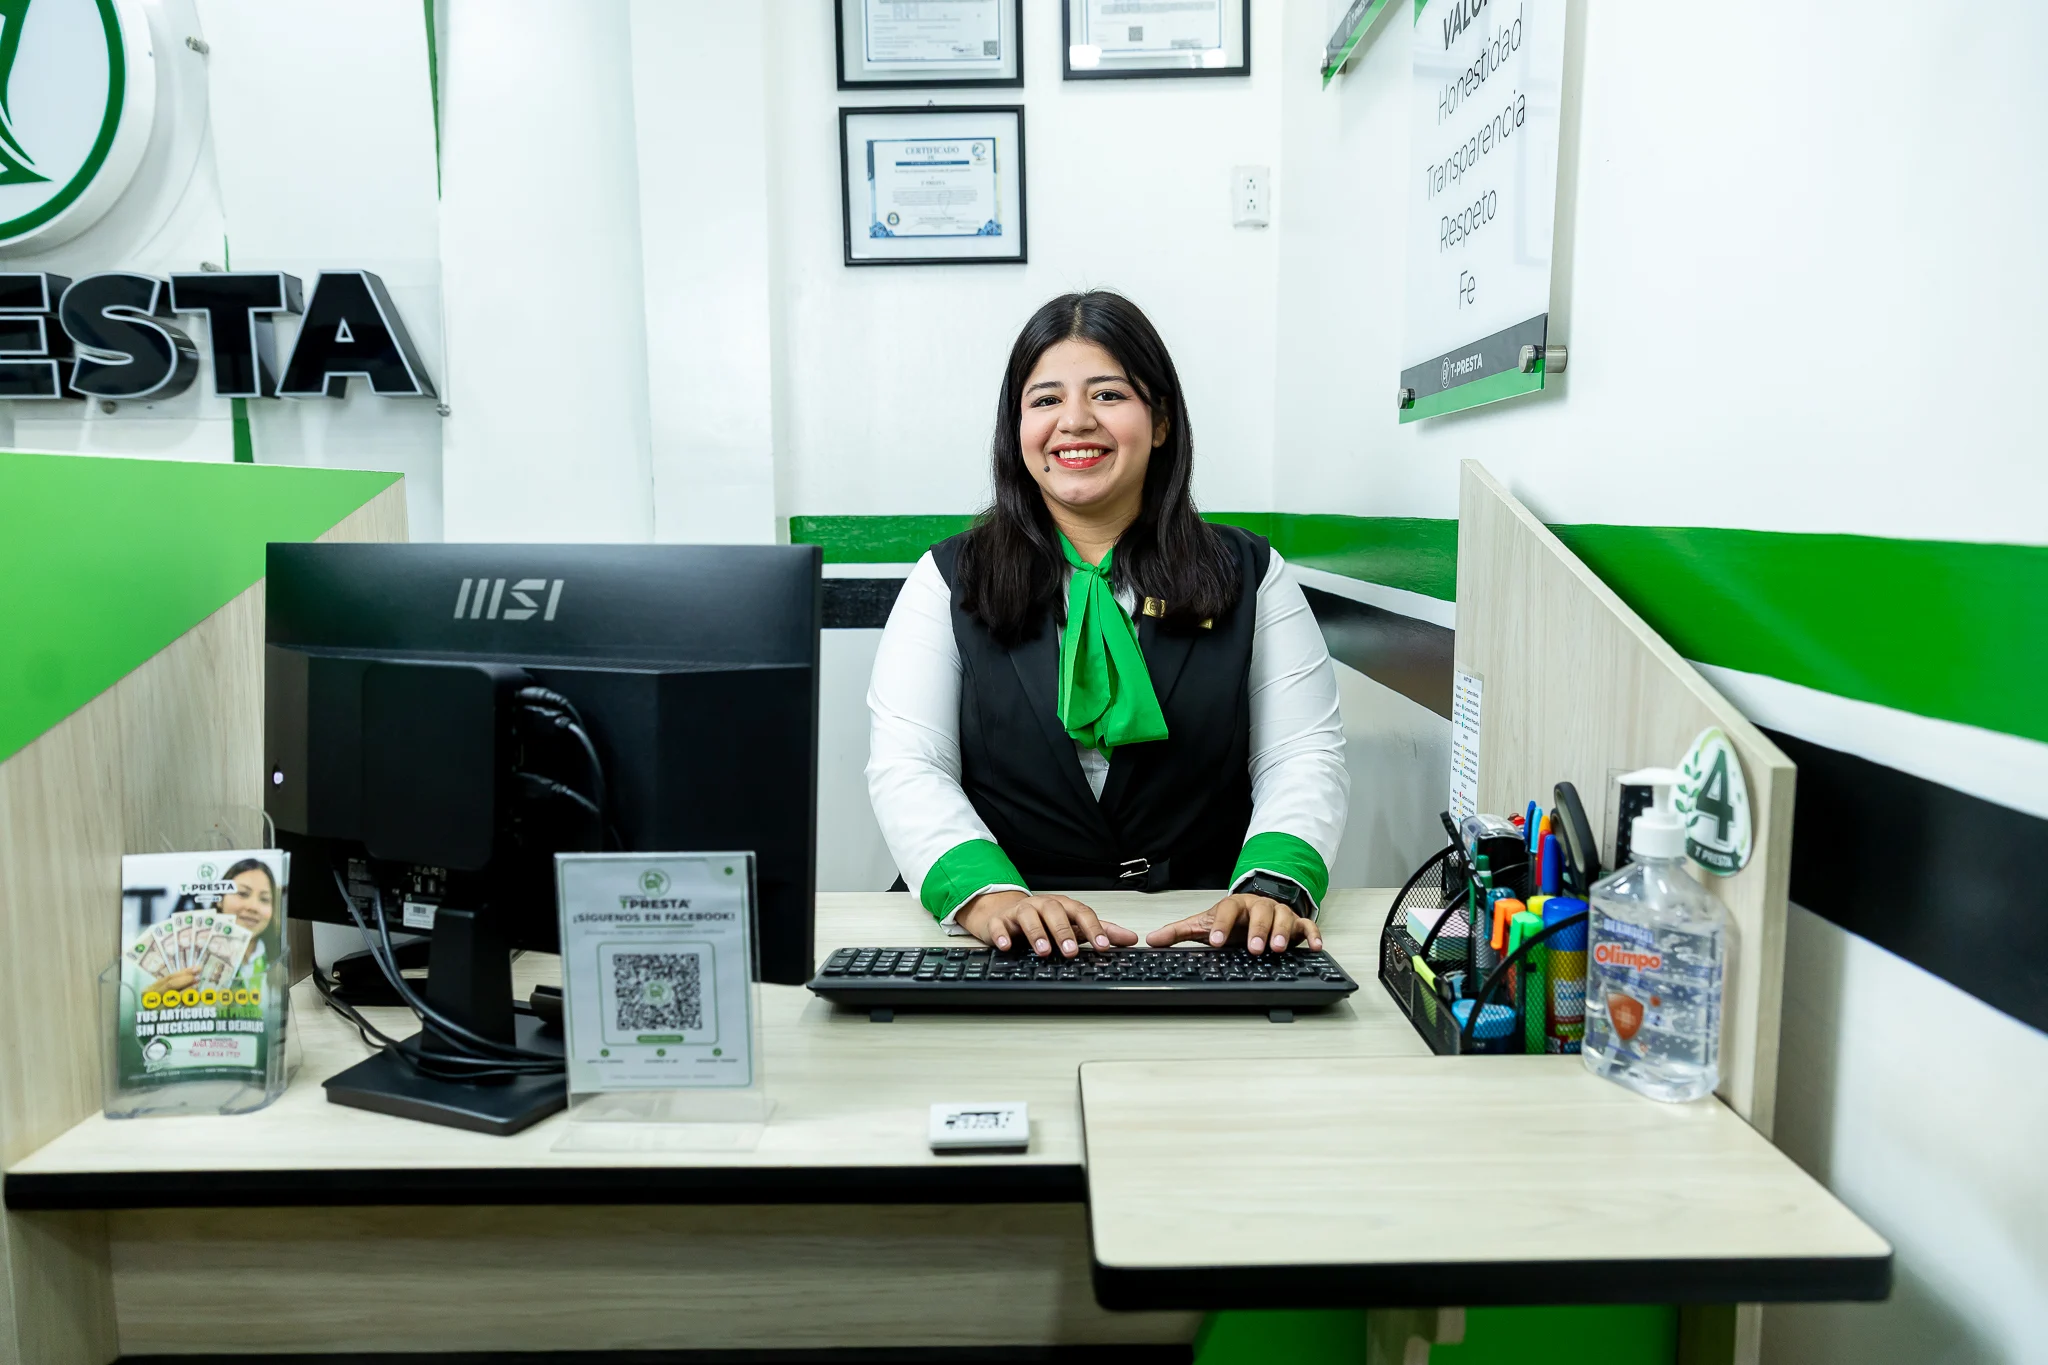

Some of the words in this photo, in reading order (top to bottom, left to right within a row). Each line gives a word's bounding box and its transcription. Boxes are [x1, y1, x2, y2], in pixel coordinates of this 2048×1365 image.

[1443, 0, 1487, 51] VALO
[1438, 2, 1523, 126] Honestidad
[1427, 89, 1526, 201] Transparencia
[1440, 189, 1497, 253] Respeto
[1459, 269, 1475, 310] Fe
[1450, 352, 1483, 378] T-PRESTA
[1695, 748, 1735, 842] 4
[181, 883, 235, 893] T-PRESTA
[645, 912, 662, 923] EN
[665, 912, 736, 923] FACEBOOK!
[1595, 944, 1662, 973] Olimpo
[136, 1010, 158, 1024] TUS
[136, 1022, 155, 1037] SIN
[156, 1019, 215, 1035] NECESIDAD
